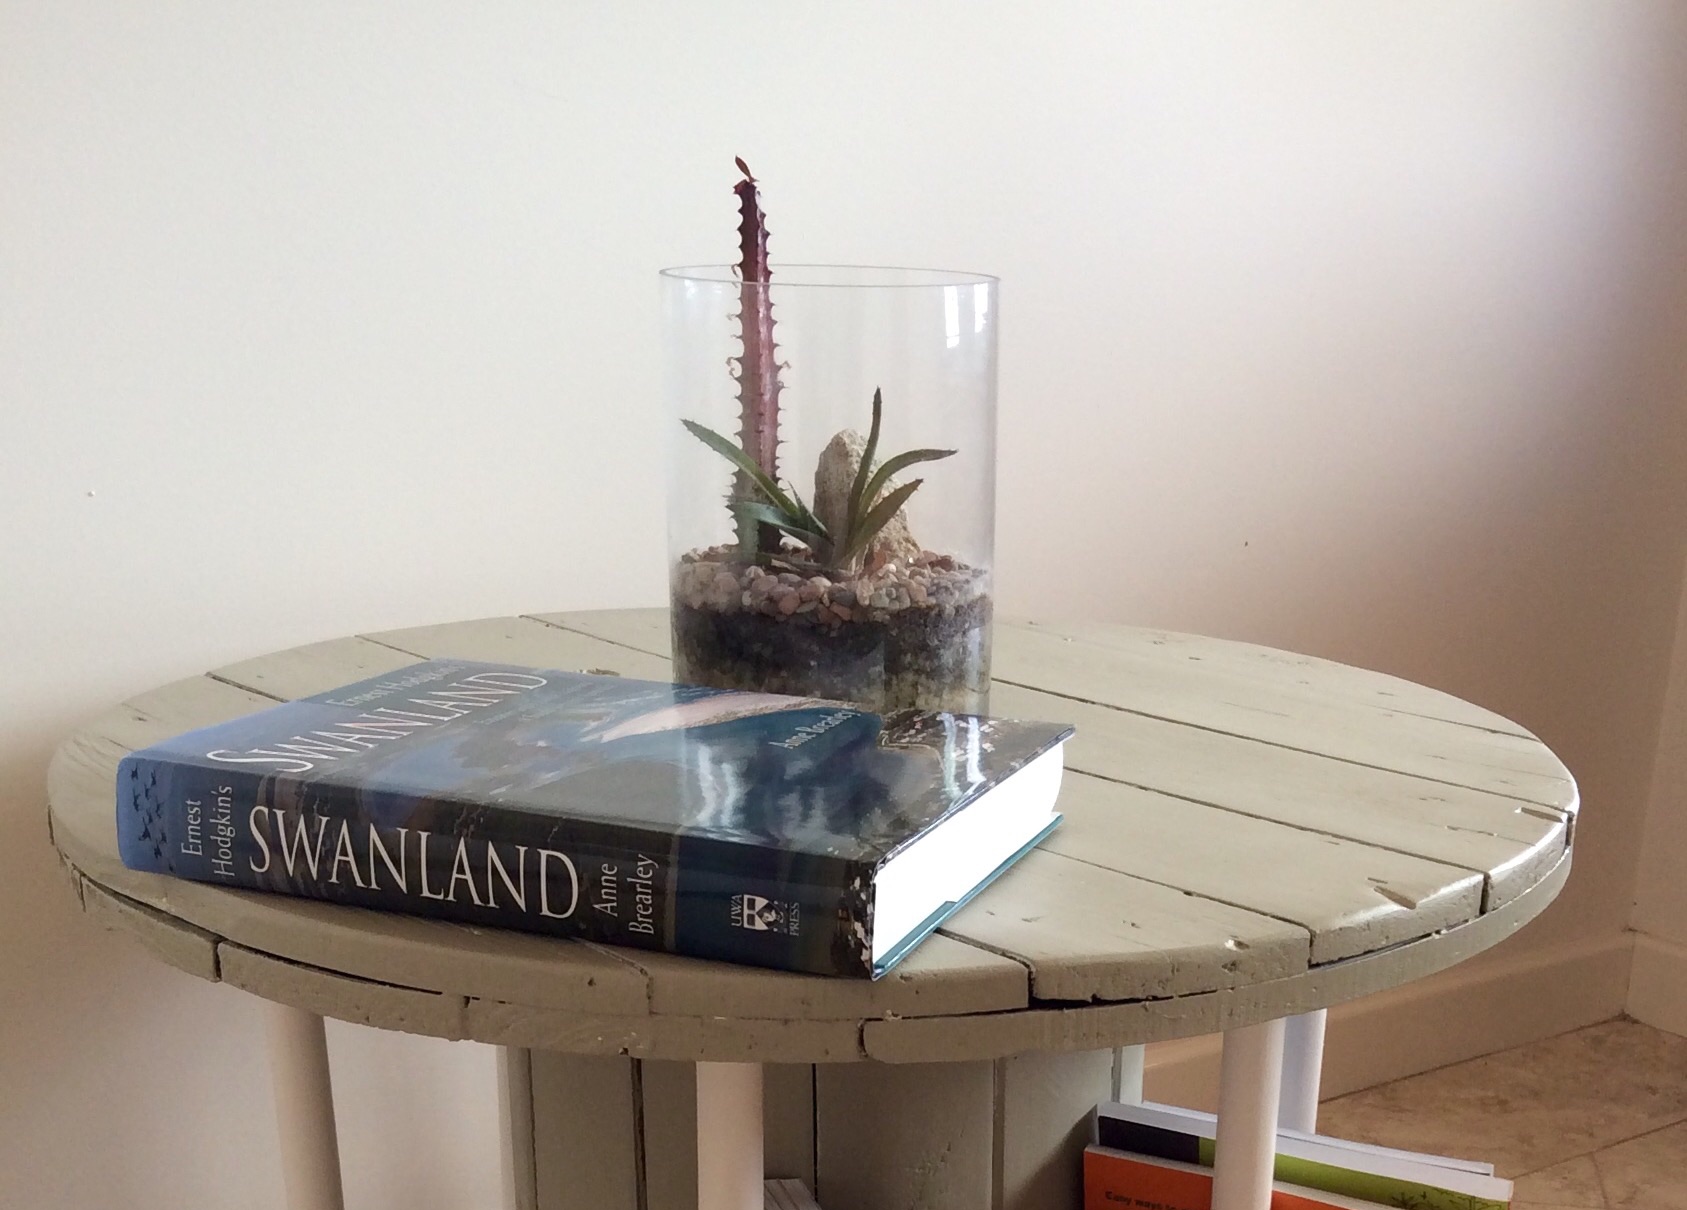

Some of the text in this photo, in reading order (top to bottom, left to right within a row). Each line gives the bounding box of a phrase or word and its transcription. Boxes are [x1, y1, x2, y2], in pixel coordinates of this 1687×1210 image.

[206, 672, 547, 773] SWANLAND
[180, 799, 202, 857] Ernest
[214, 784, 236, 878] Hodgkin's
[249, 805, 579, 920] SWANLAND
[592, 862, 619, 917] Anne
[628, 853, 660, 936] Brearley
[730, 894, 743, 928] UWA
[789, 902, 800, 937] PRESS
